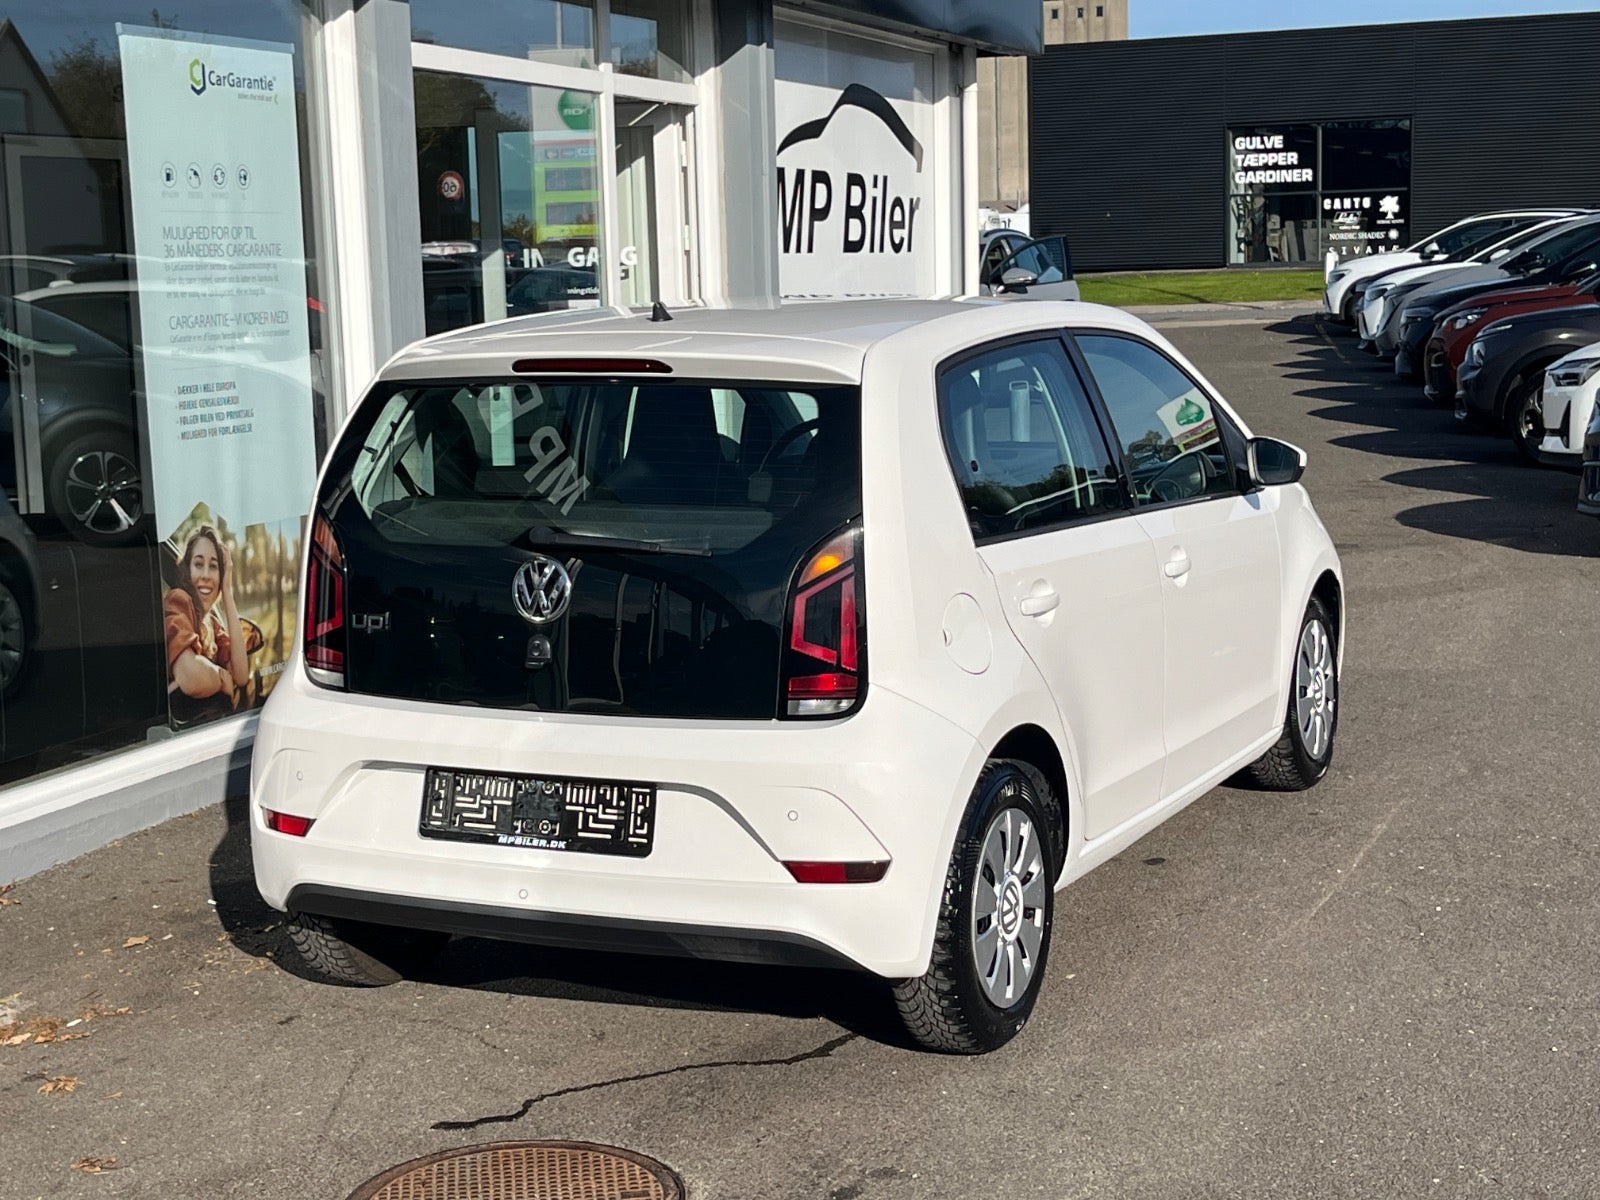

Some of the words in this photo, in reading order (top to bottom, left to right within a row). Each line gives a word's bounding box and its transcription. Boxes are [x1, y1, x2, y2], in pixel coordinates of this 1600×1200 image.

[208, 70, 274, 91] CarGarantie
[1234, 135, 1284, 150] GULVE
[1235, 152, 1299, 167] TÆPPER
[1235, 168, 1313, 184] GARDINER
[776, 167, 832, 254] MP
[843, 172, 921, 254] Biler
[1323, 197, 1372, 210] CANTO
[163, 226, 210, 241] MULIGHED
[211, 226, 229, 241] FOR
[231, 226, 243, 240] OP
[245, 226, 257, 240] TIL
[164, 244, 175, 258] 36
[177, 241, 225, 257] MÅNEDERS
[226, 243, 283, 257] CARGARANTIE
[498, 835, 567, 849] MPBILER.DK
